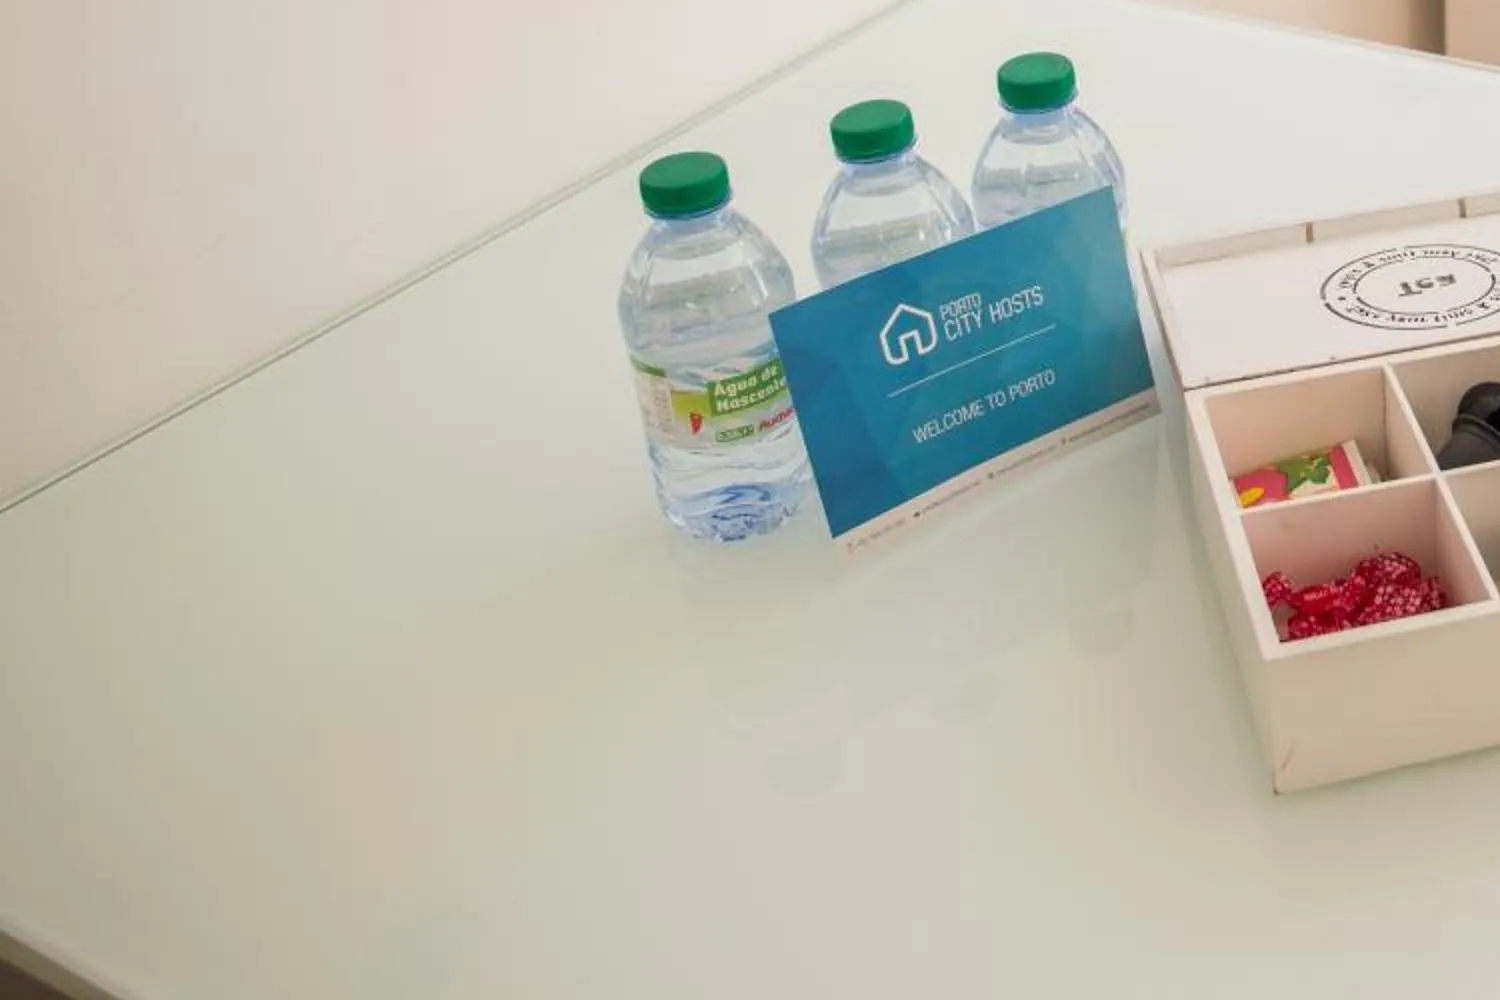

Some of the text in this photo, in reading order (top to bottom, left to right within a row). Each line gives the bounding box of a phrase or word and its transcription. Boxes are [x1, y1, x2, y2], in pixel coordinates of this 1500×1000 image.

[938, 292, 983, 321] PORTO
[943, 285, 1045, 342] CITY HOSTS
[761, 364, 778, 381] de
[912, 368, 1057, 444] WELCOME TO PORTO
